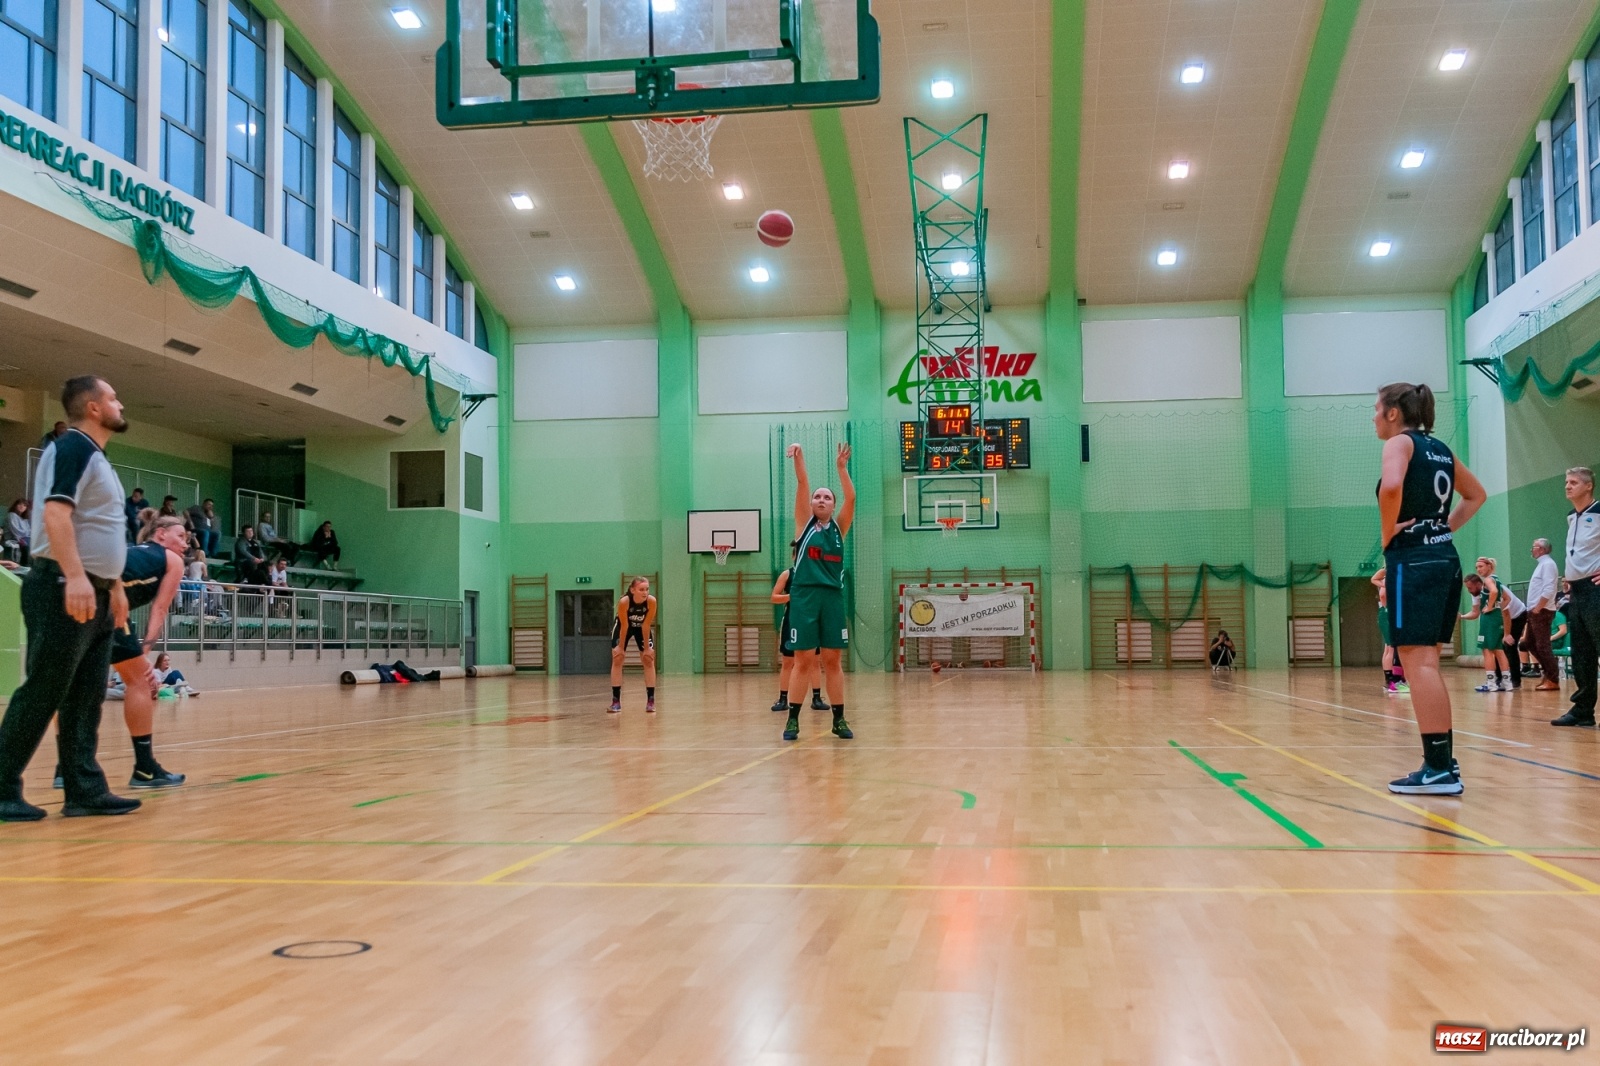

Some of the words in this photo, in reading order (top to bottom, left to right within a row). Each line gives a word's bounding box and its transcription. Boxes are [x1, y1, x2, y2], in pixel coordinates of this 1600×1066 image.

[110, 168, 195, 235] RACIBÓRZ
[887, 349, 1043, 404] Arena
[945, 420, 961, 433] 14
[933, 456, 949, 468] 51
[986, 454, 1003, 466] 35
[941, 618, 960, 630] JEST
[961, 615, 969, 623] W
[790, 627, 798, 643] 9
